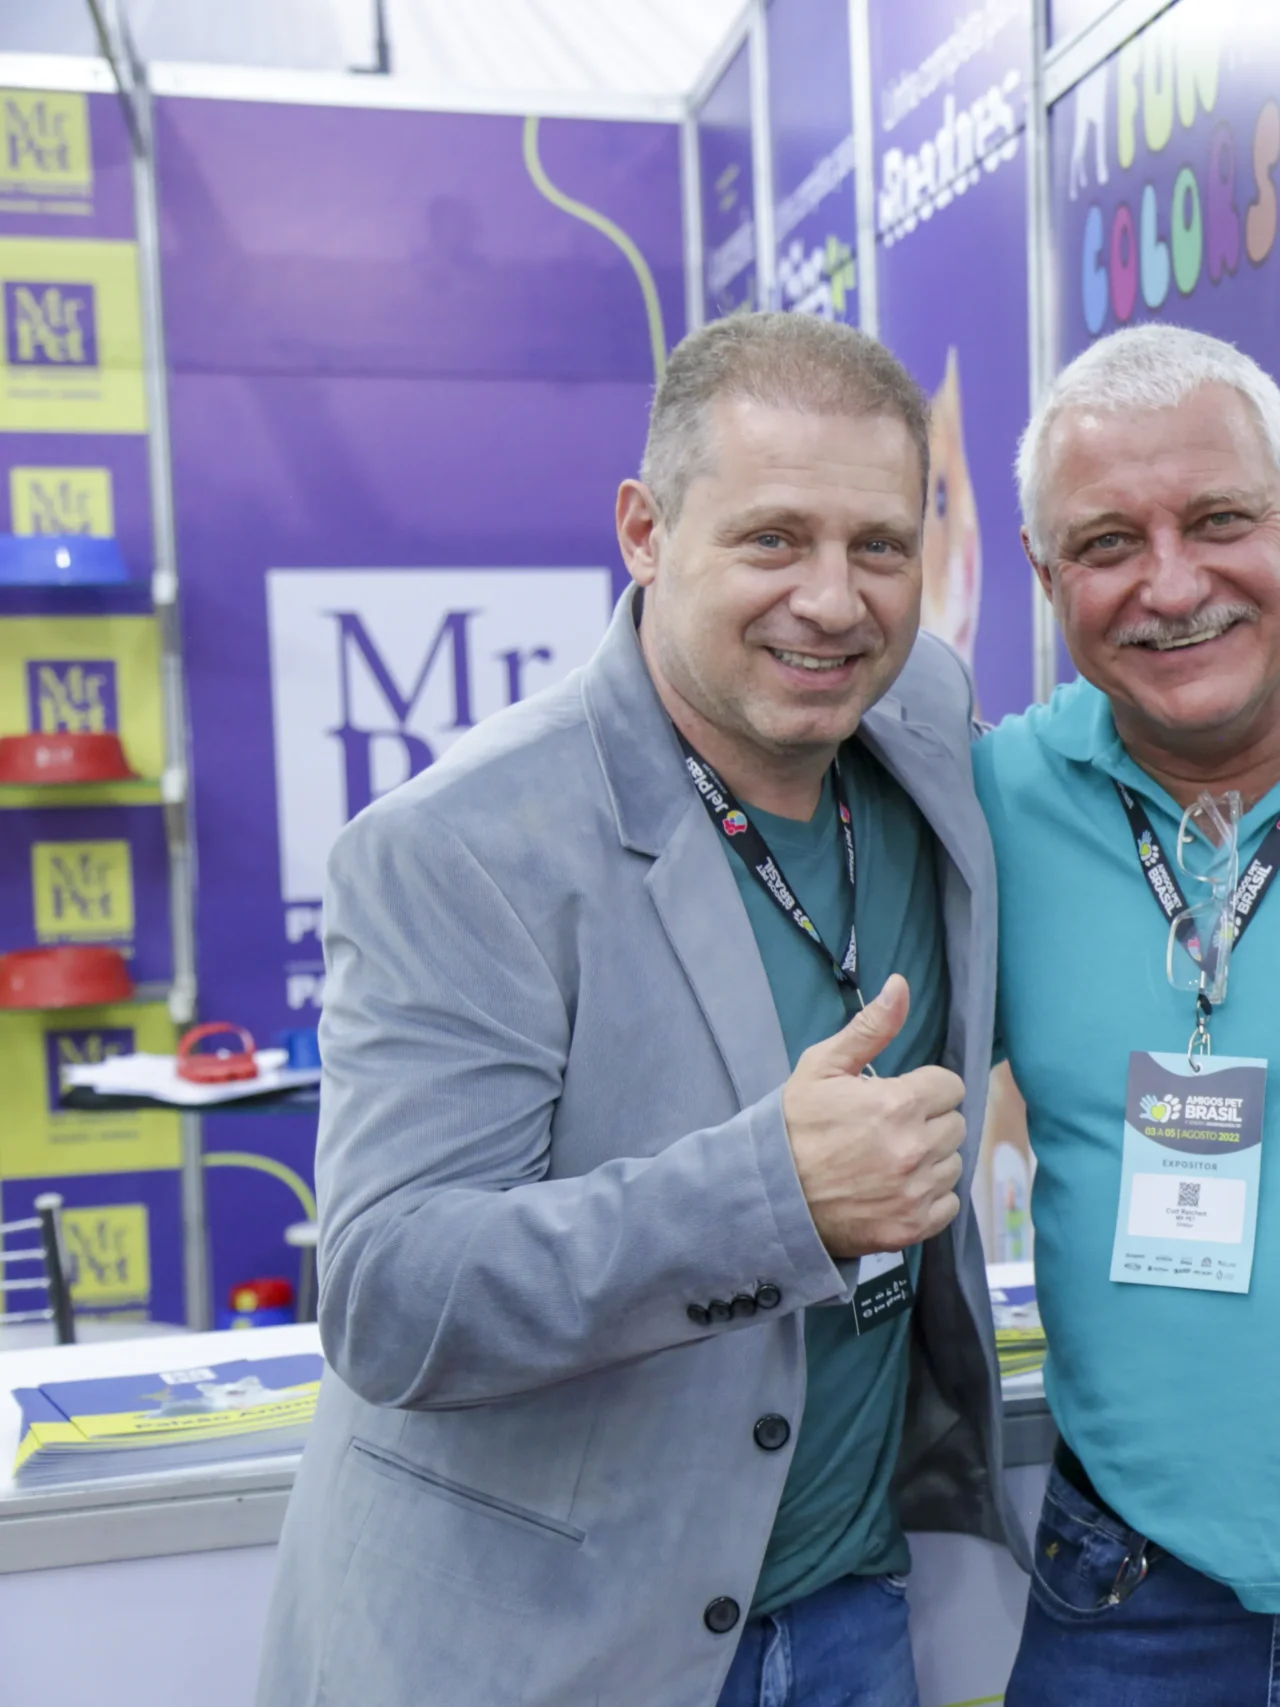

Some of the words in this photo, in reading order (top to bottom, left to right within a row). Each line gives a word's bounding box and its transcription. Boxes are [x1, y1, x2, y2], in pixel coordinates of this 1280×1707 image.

[319, 606, 555, 734] Mr
[764, 856, 796, 911] BRASIL
[1147, 866, 1173, 918] BRASIL
[1236, 864, 1273, 916] BRASIL
[1184, 1104, 1243, 1123] BRASIL
[1186, 1095, 1223, 1107] AMIGOS
[1224, 1097, 1244, 1109] PET
[1180, 1129, 1217, 1141] AGOSTO
[1218, 1131, 1241, 1143] 2022
[1162, 1158, 1219, 1172] EXPOSITOR
